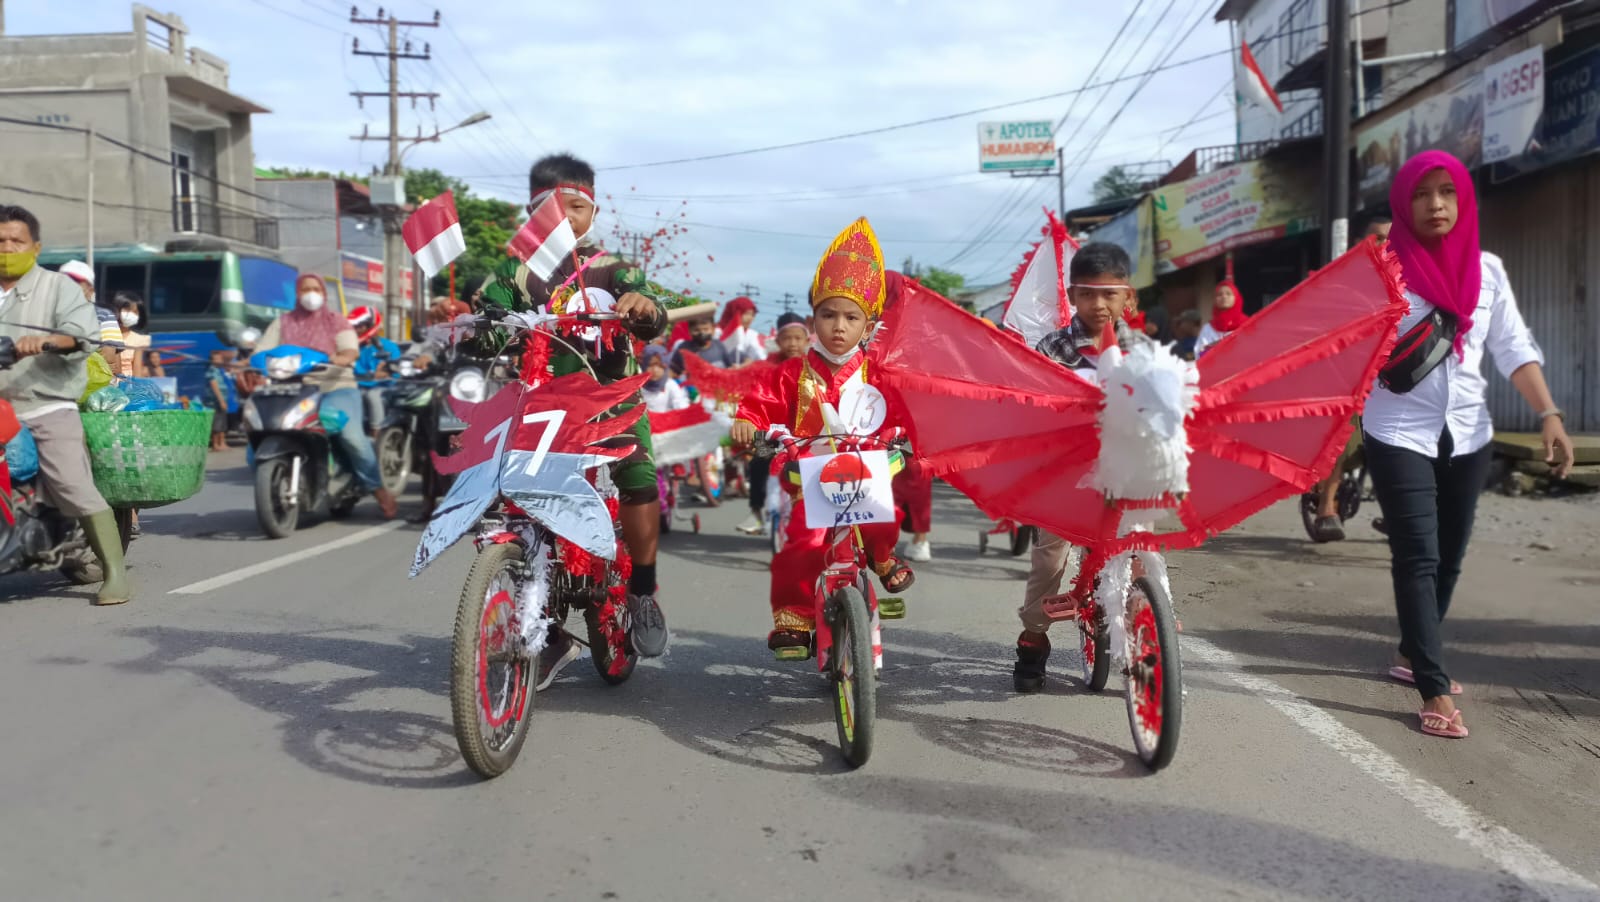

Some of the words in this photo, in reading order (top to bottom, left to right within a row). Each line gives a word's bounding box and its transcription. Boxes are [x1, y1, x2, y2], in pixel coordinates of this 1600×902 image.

[1000, 121, 1052, 140] APOTEK
[848, 387, 882, 429] 13
[484, 410, 567, 477] 17
[833, 473, 857, 492] 77
[831, 491, 852, 504] HUT
